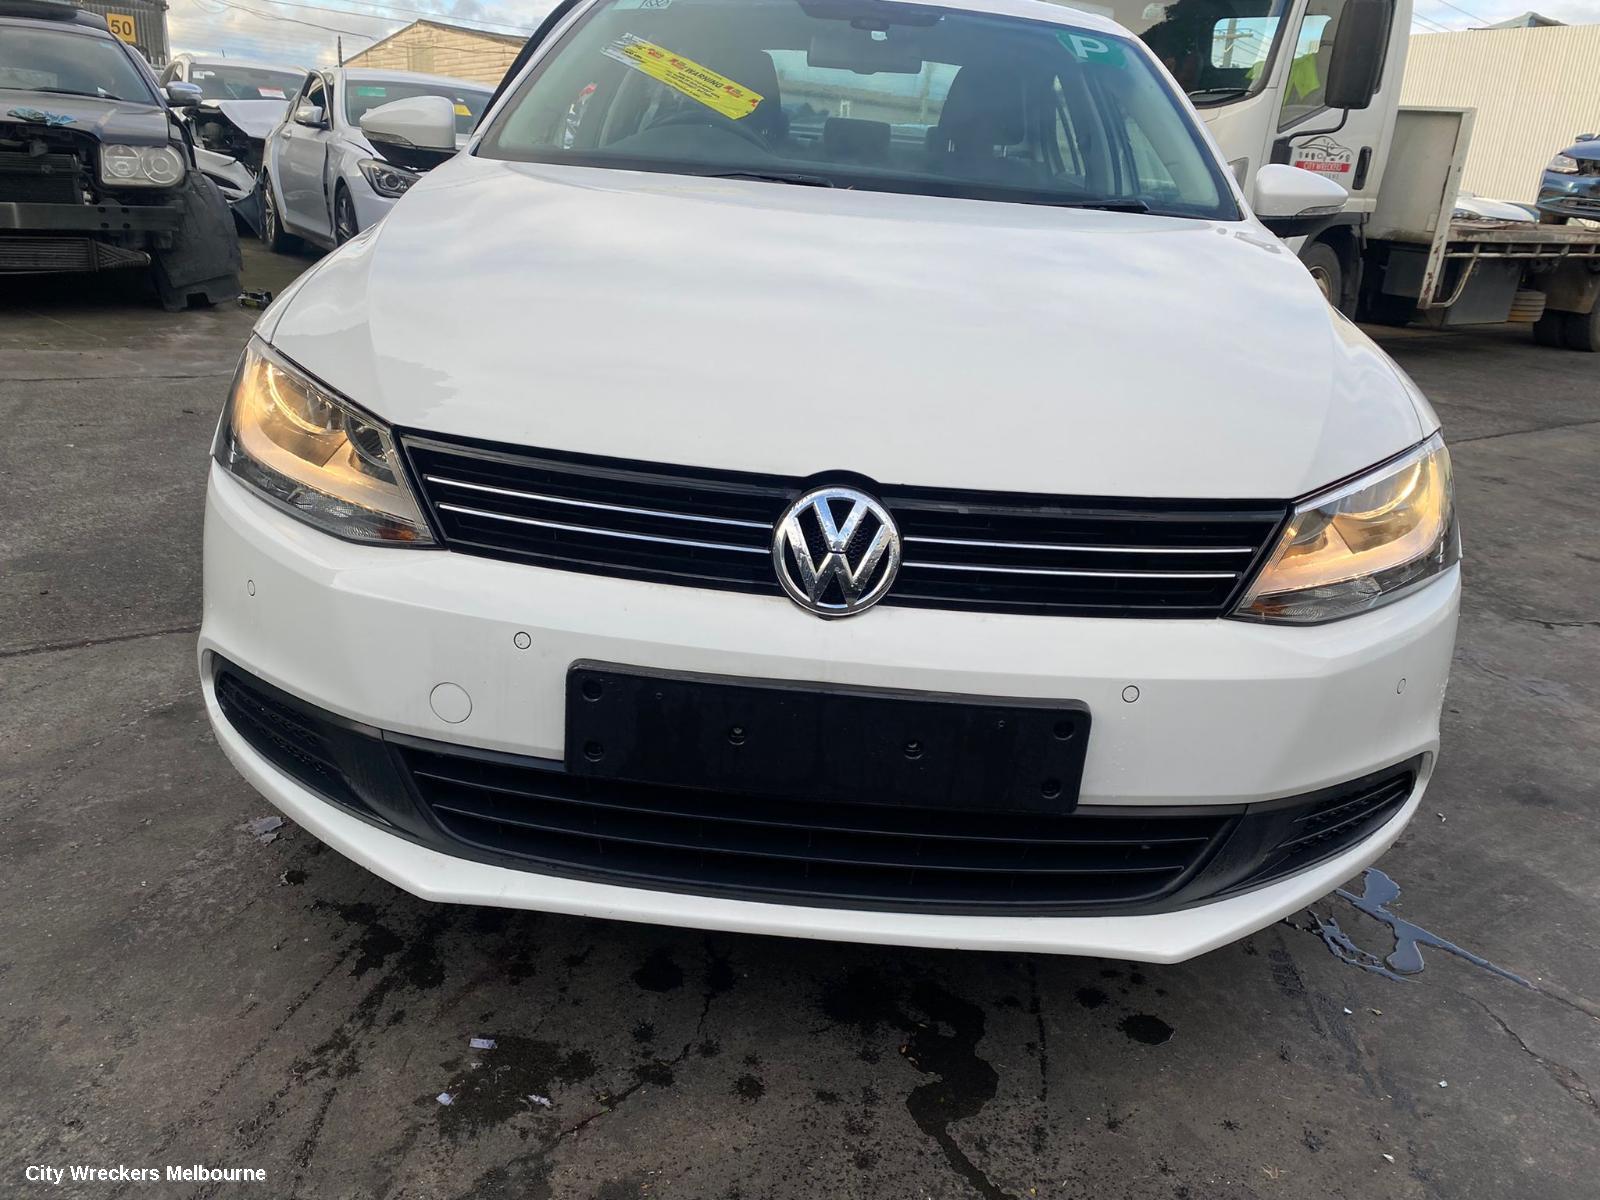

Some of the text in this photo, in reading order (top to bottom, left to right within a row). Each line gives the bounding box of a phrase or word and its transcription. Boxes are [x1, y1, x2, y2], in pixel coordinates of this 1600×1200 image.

[111, 20, 132, 36] 50
[1068, 34, 1109, 58] P
[684, 67, 724, 88] WARNING
